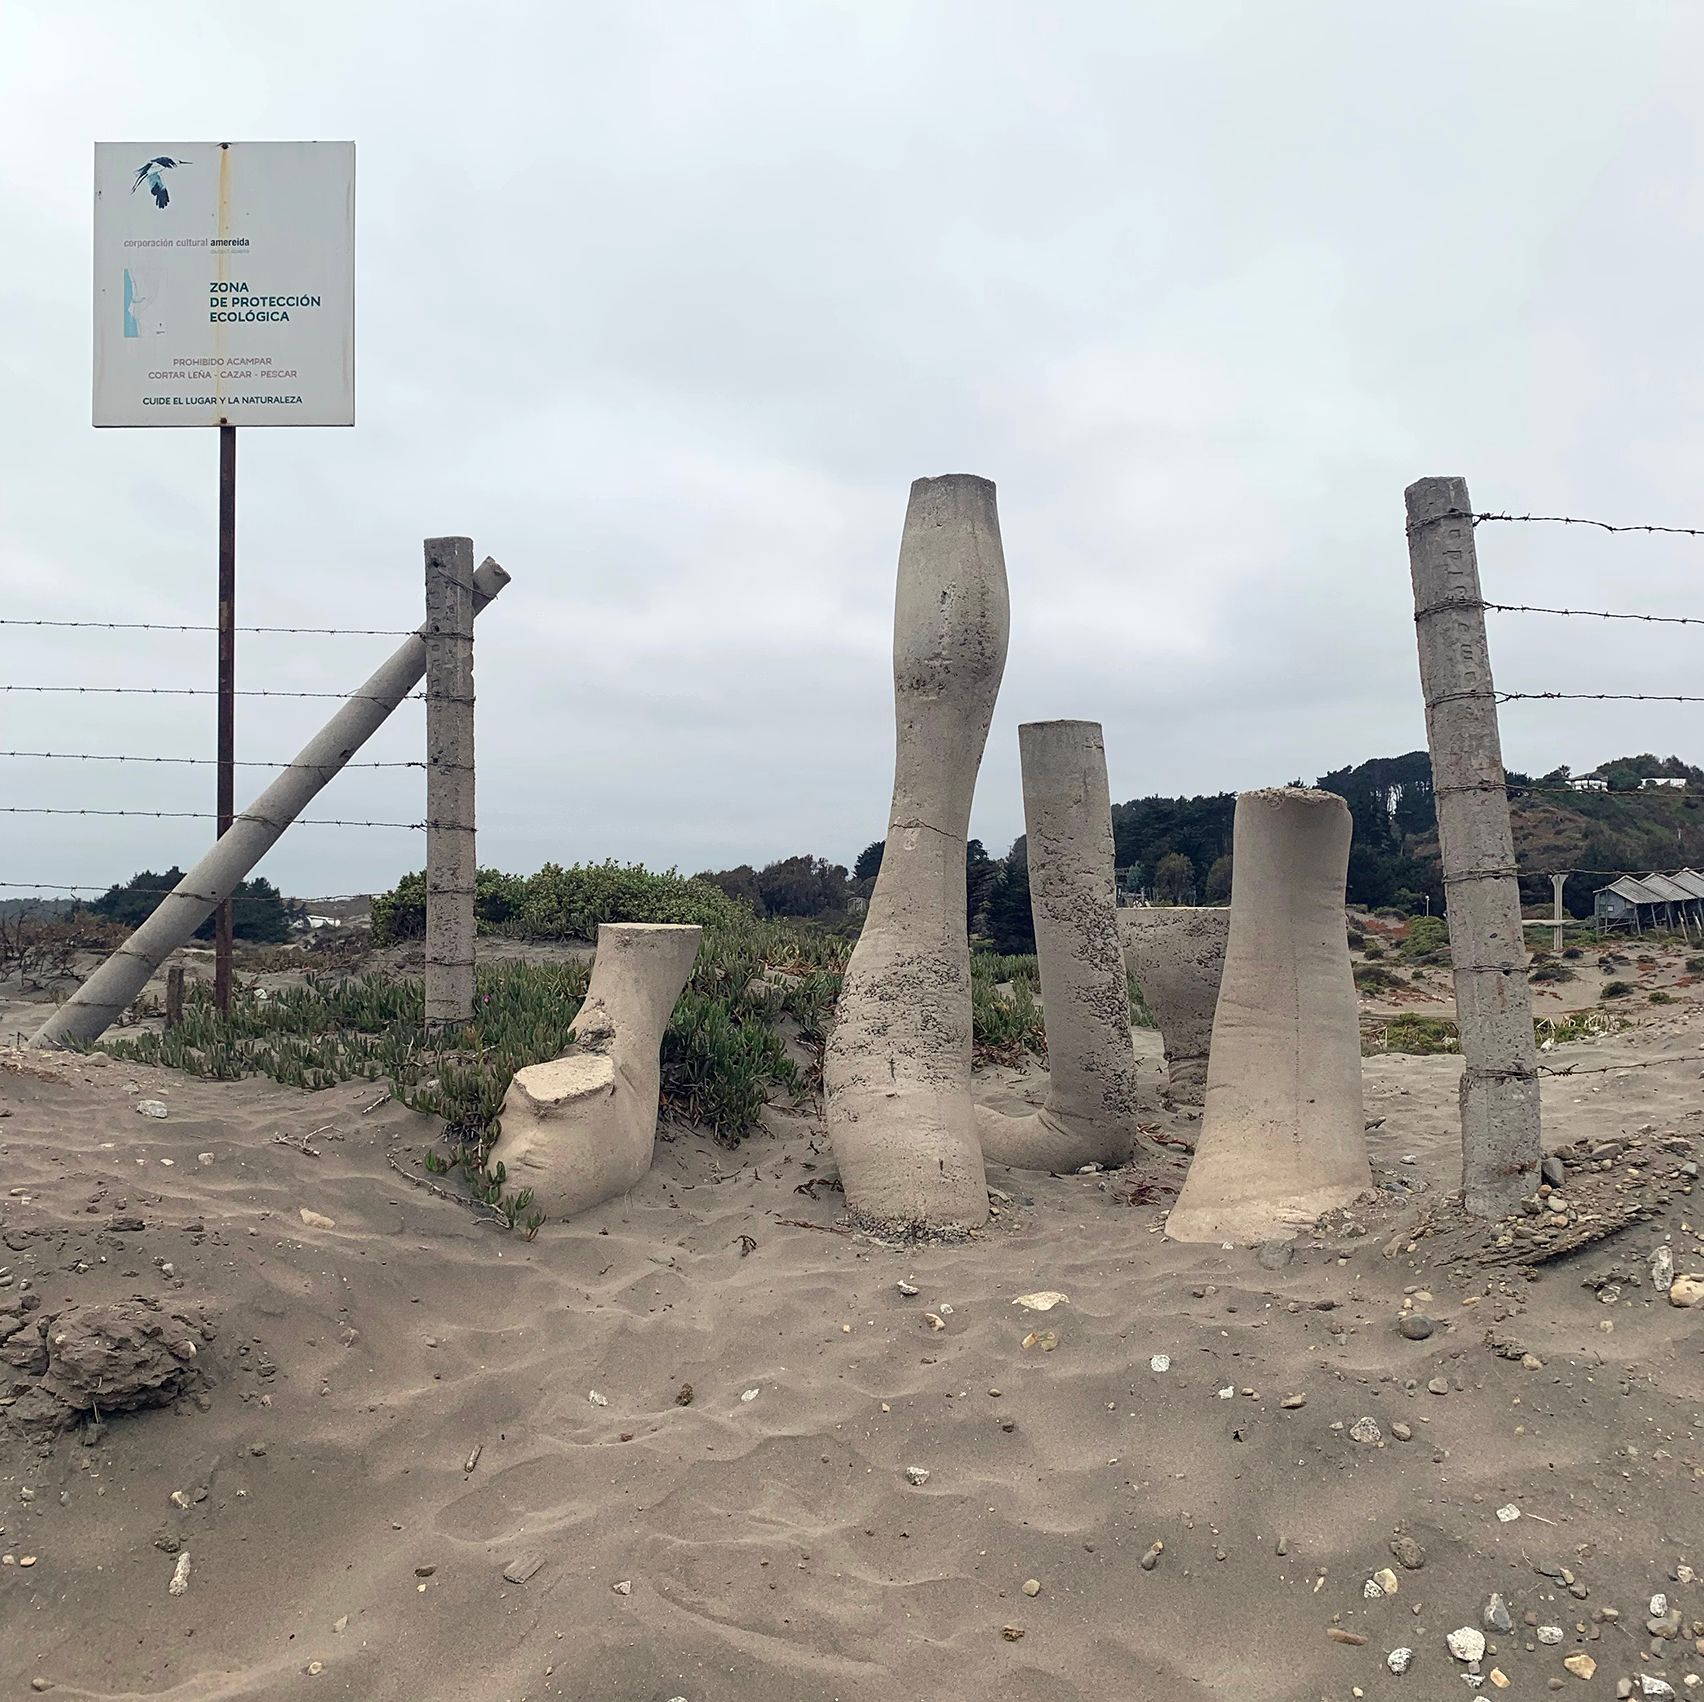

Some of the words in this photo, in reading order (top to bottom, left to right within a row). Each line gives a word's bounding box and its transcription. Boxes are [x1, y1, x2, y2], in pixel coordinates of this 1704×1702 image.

[124, 238, 173, 248] corporación
[176, 238, 208, 247] cultural
[210, 237, 250, 247] amereida
[210, 282, 249, 293] ZONA
[210, 297, 227, 308] DE
[232, 294, 321, 307] PROTECCIÓN
[210, 309, 290, 322] ECOLÓGICA
[173, 358, 225, 366] PROHIBIDO
[227, 357, 272, 366] ACAMPAR
[148, 371, 186, 379] CORTAR
[188, 370, 212, 379] LEÑA
[220, 371, 252, 379] CAZAR
[261, 370, 297, 378] PESCAR
[143, 397, 171, 405] CUIDE
[173, 397, 184, 405] EL
[186, 397, 217, 405] LUGAR
[242, 396, 303, 404] NATURALEZA
